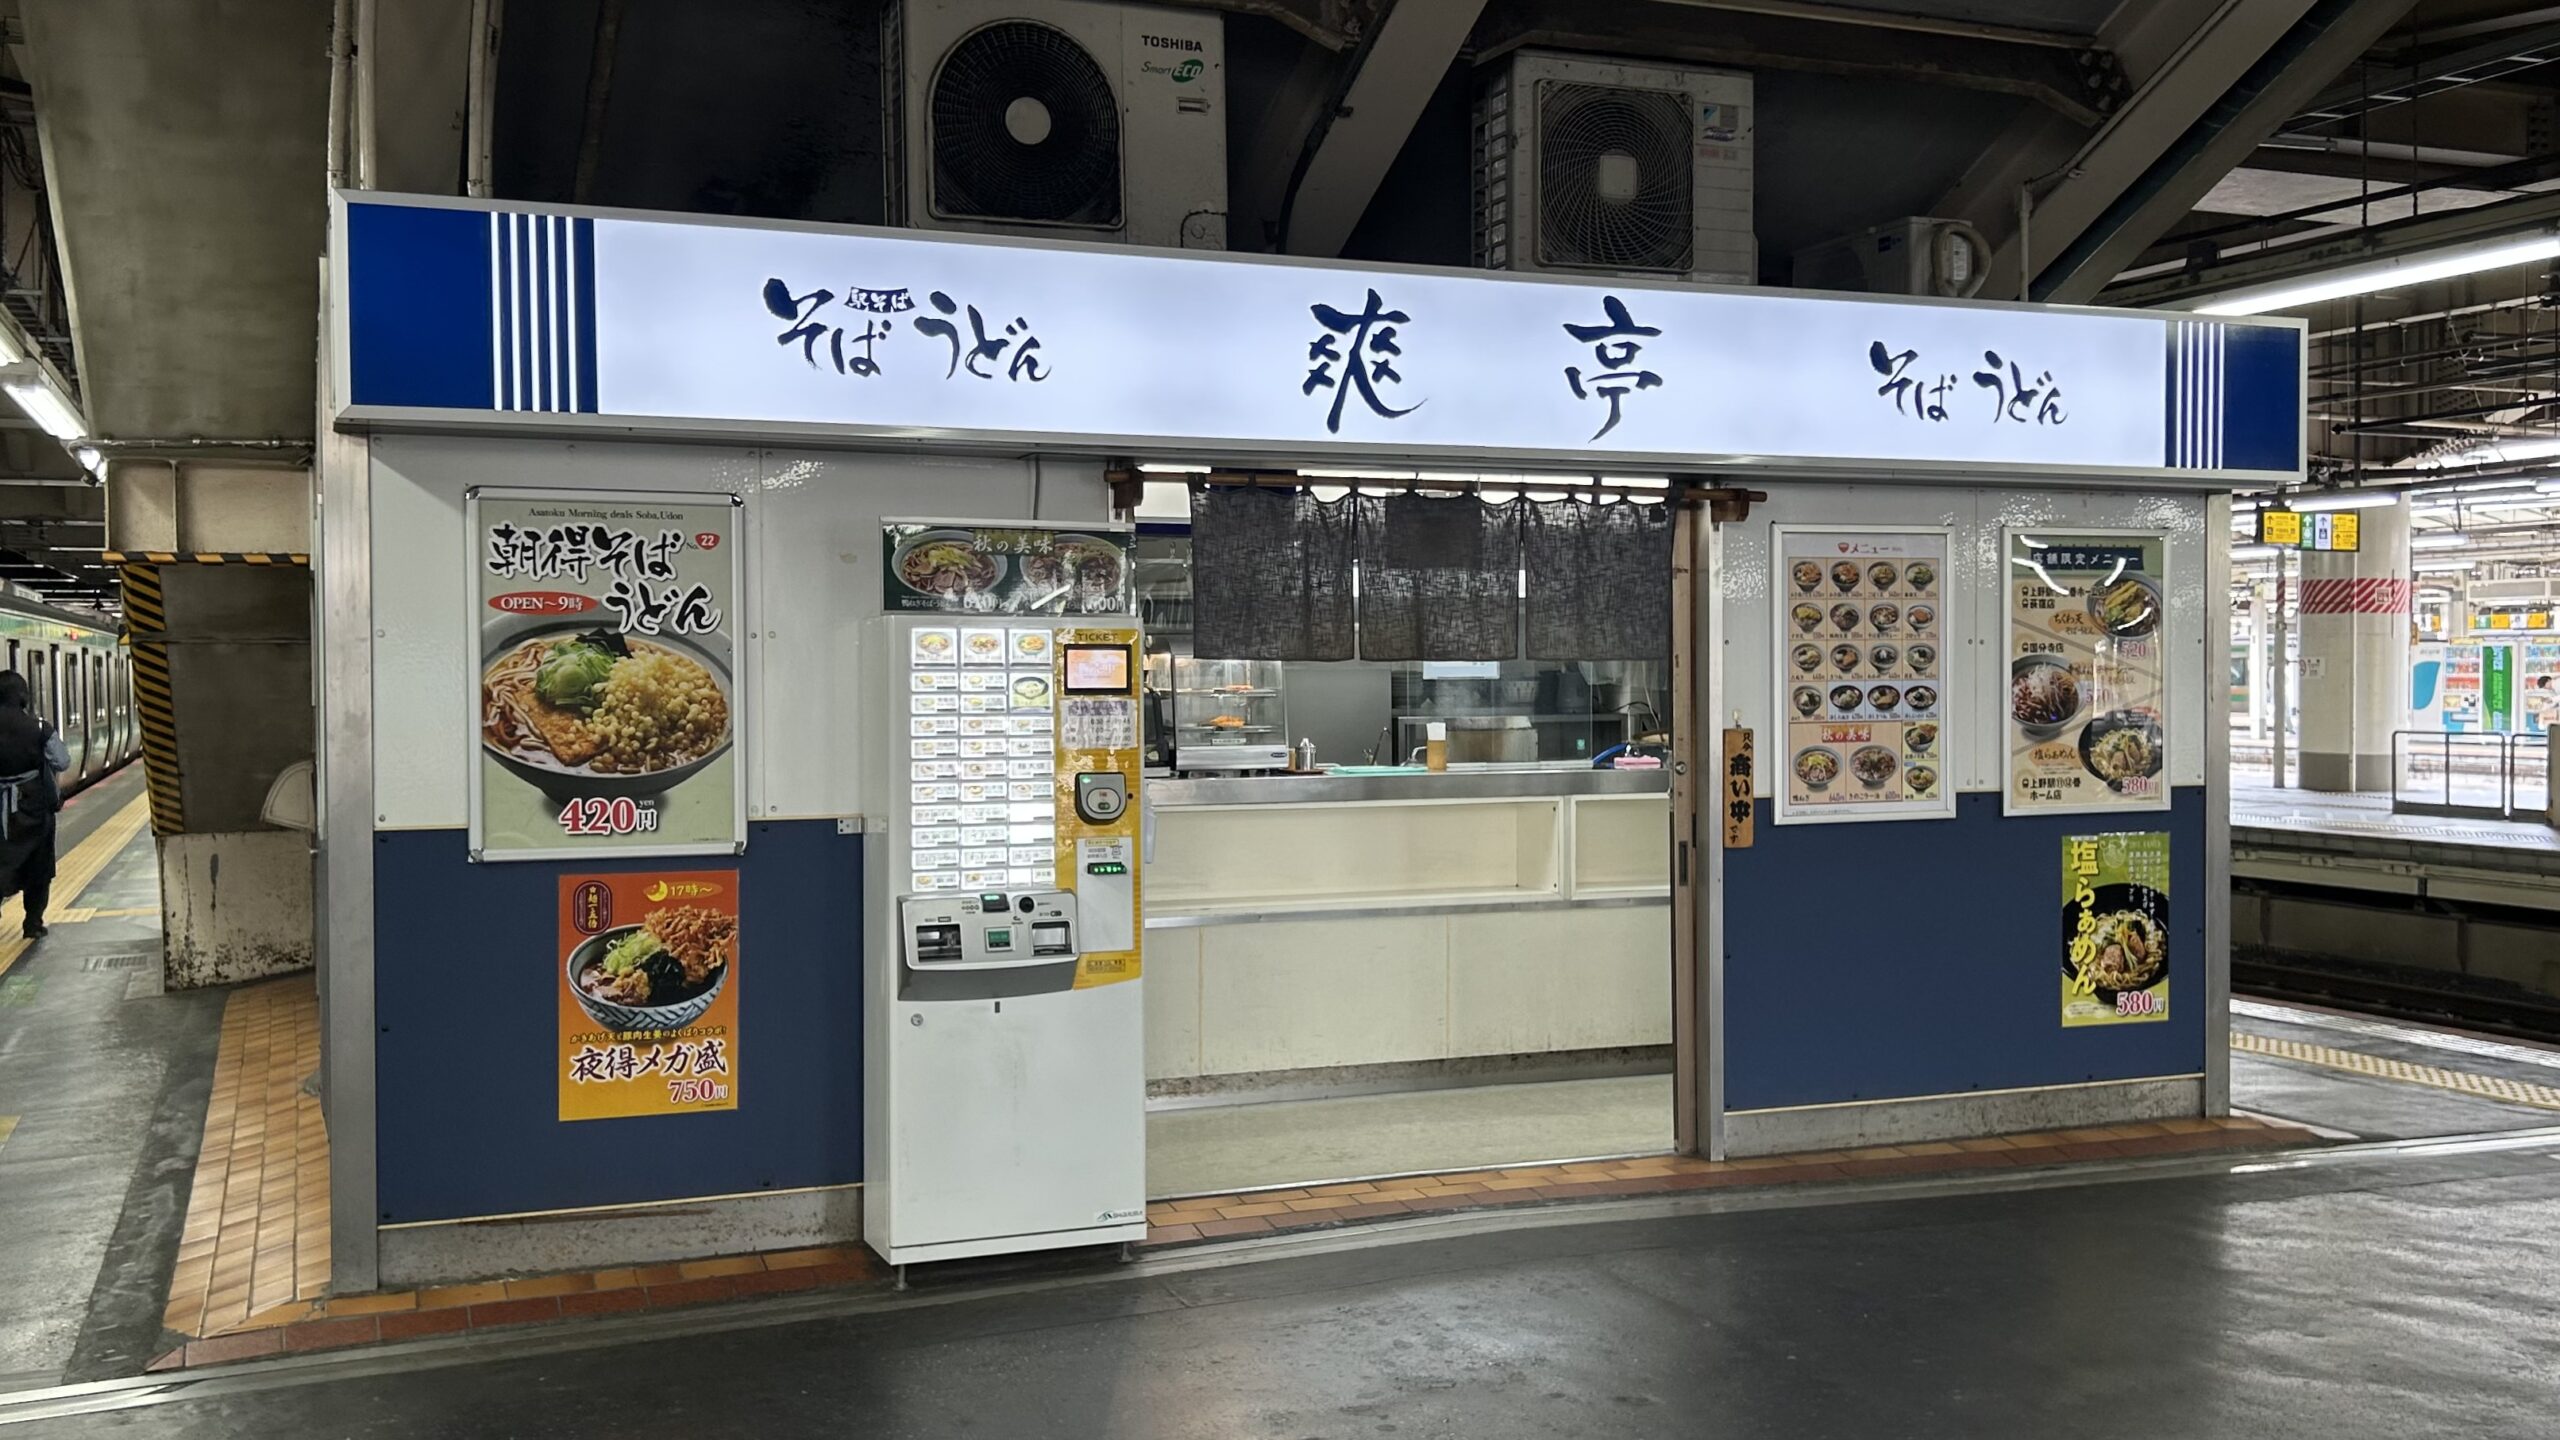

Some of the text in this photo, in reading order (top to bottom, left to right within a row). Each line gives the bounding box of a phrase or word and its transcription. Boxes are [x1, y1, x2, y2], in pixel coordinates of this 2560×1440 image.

[1141, 35, 1204, 52] TOSHIBA
[1141, 60, 1172, 76] Smart
[763, 278, 1051, 382] そば うどん
[1870, 341, 2068, 425] そば うどん
[528, 507, 566, 518] Asatoku
[568, 508, 608, 520] Morning
[610, 509, 634, 520] deals
[700, 534, 714, 547] 22
[973, 534, 1054, 554] 秋の美味
[1851, 543, 1889, 554] メニュー
[489, 523, 684, 581] 朝得そば
[2032, 552, 2139, 566] 店舗限定メニー
[603, 582, 722, 633] うどん
[2053, 612, 2084, 625] ちくわ天
[1076, 632, 1118, 641] TICKET
[2030, 642, 2064, 653] 国分寺店
[1822, 727, 1870, 741] 秋の美味
[1729, 753, 1752, 824] 商い中
[2029, 790, 2063, 801] ホーム店
[559, 798, 658, 835] 420円
[2071, 841, 2099, 995] 塩らぁめん
[2116, 991, 2164, 1016] 580円
[571, 1040, 727, 1080] 夜得メガ盛
[668, 1078, 728, 1103] 750円
